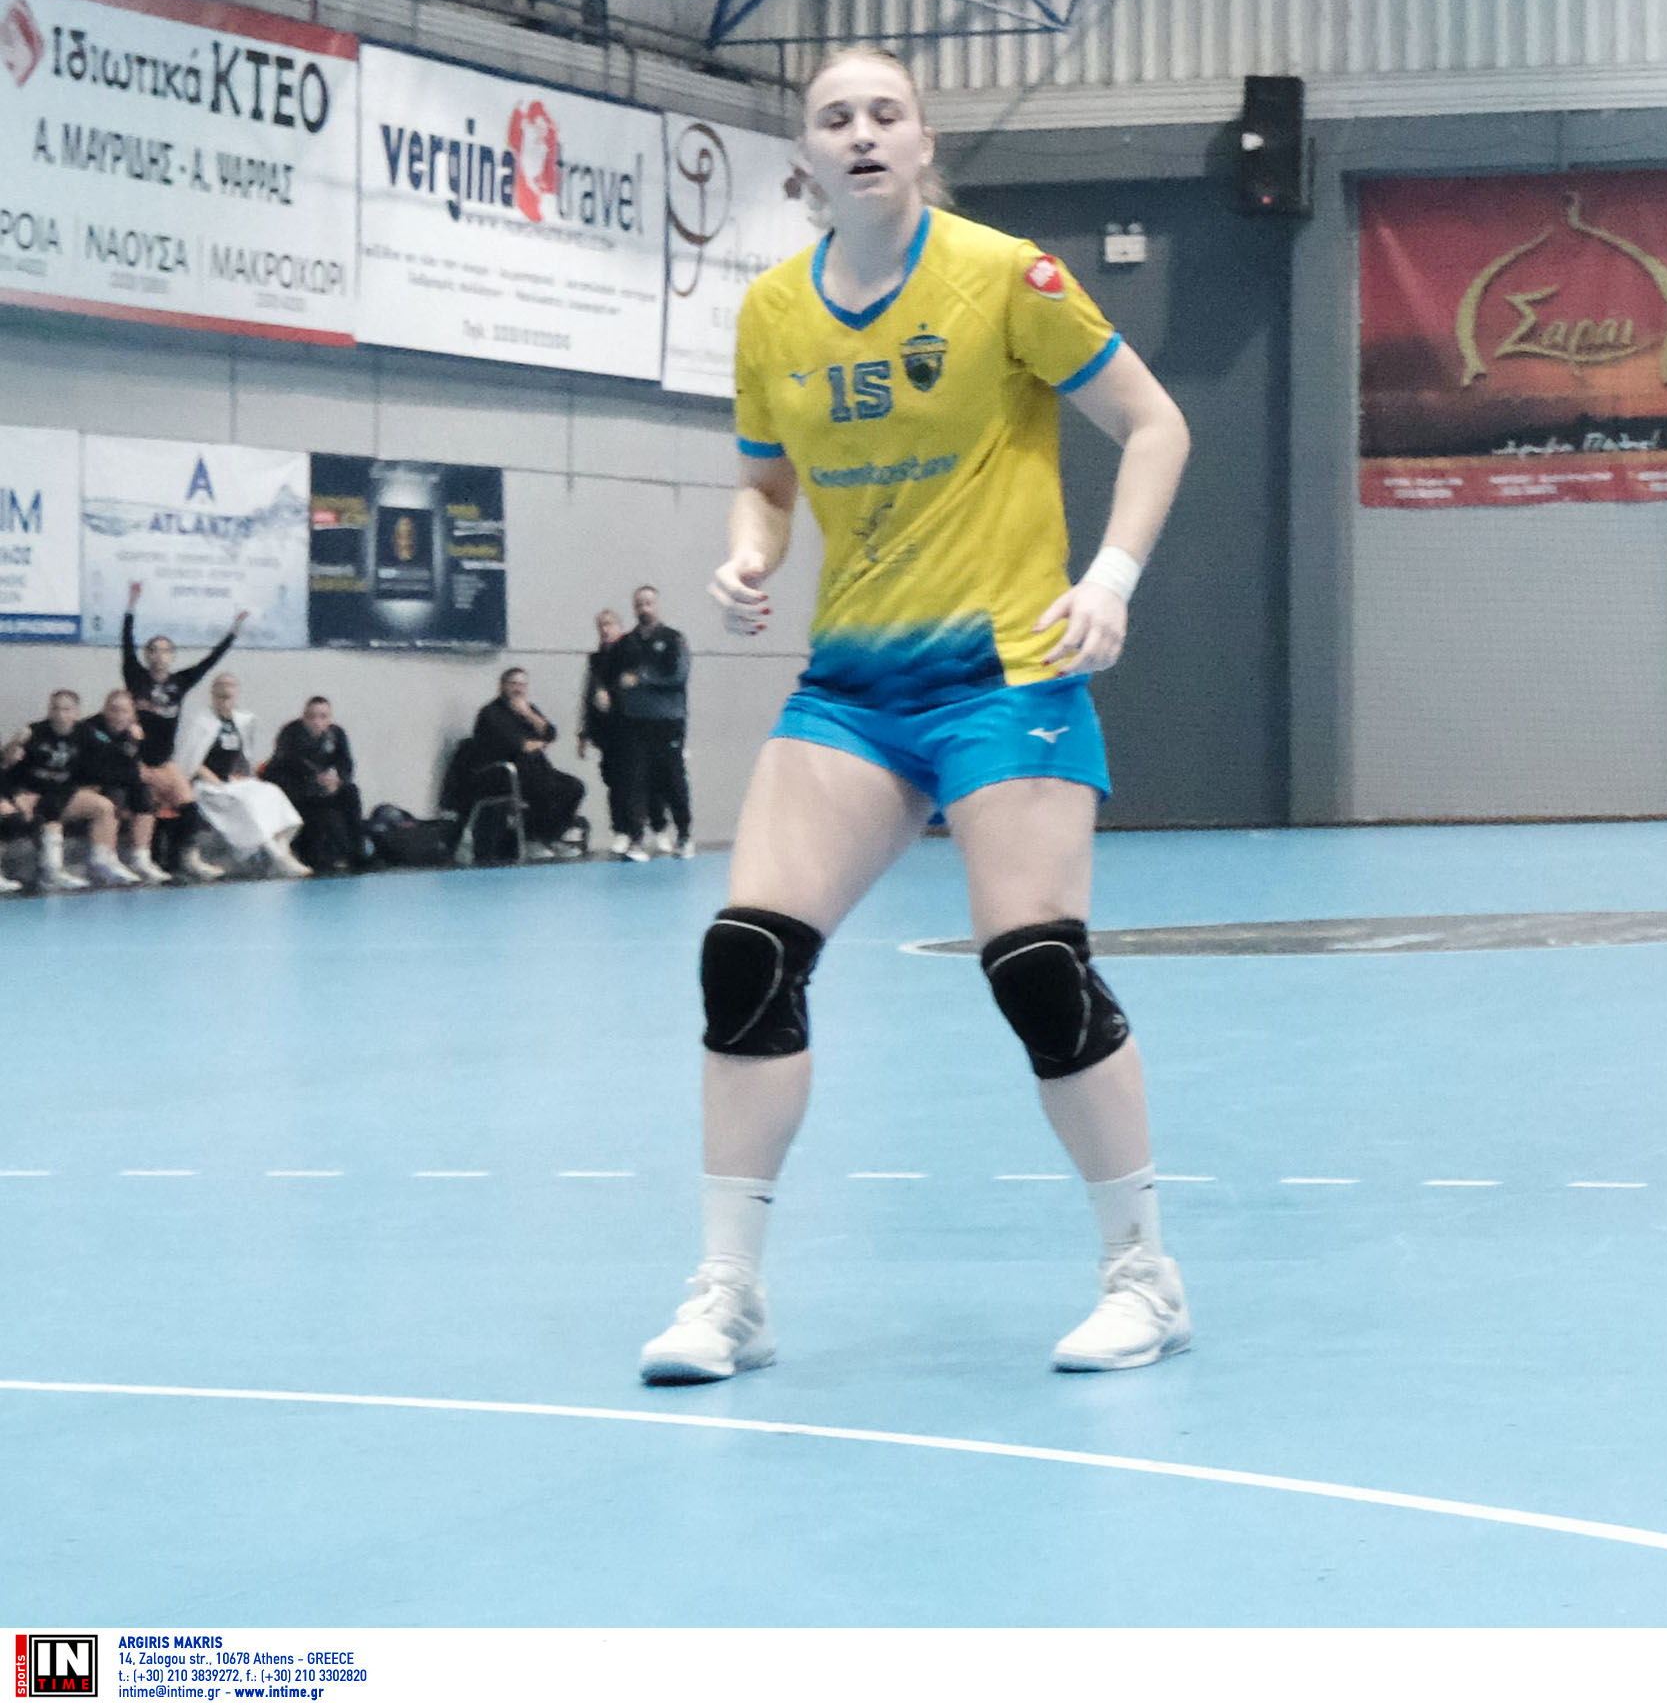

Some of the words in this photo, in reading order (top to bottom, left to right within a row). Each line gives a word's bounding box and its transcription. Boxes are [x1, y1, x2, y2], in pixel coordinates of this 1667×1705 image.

[209, 40, 330, 135] ΚΤΕΟ
[380, 117, 515, 222] vergina
[556, 152, 645, 235] travel
[84, 223, 191, 276] ΝΑΟΥΣΑ
[827, 360, 894, 423] 15
